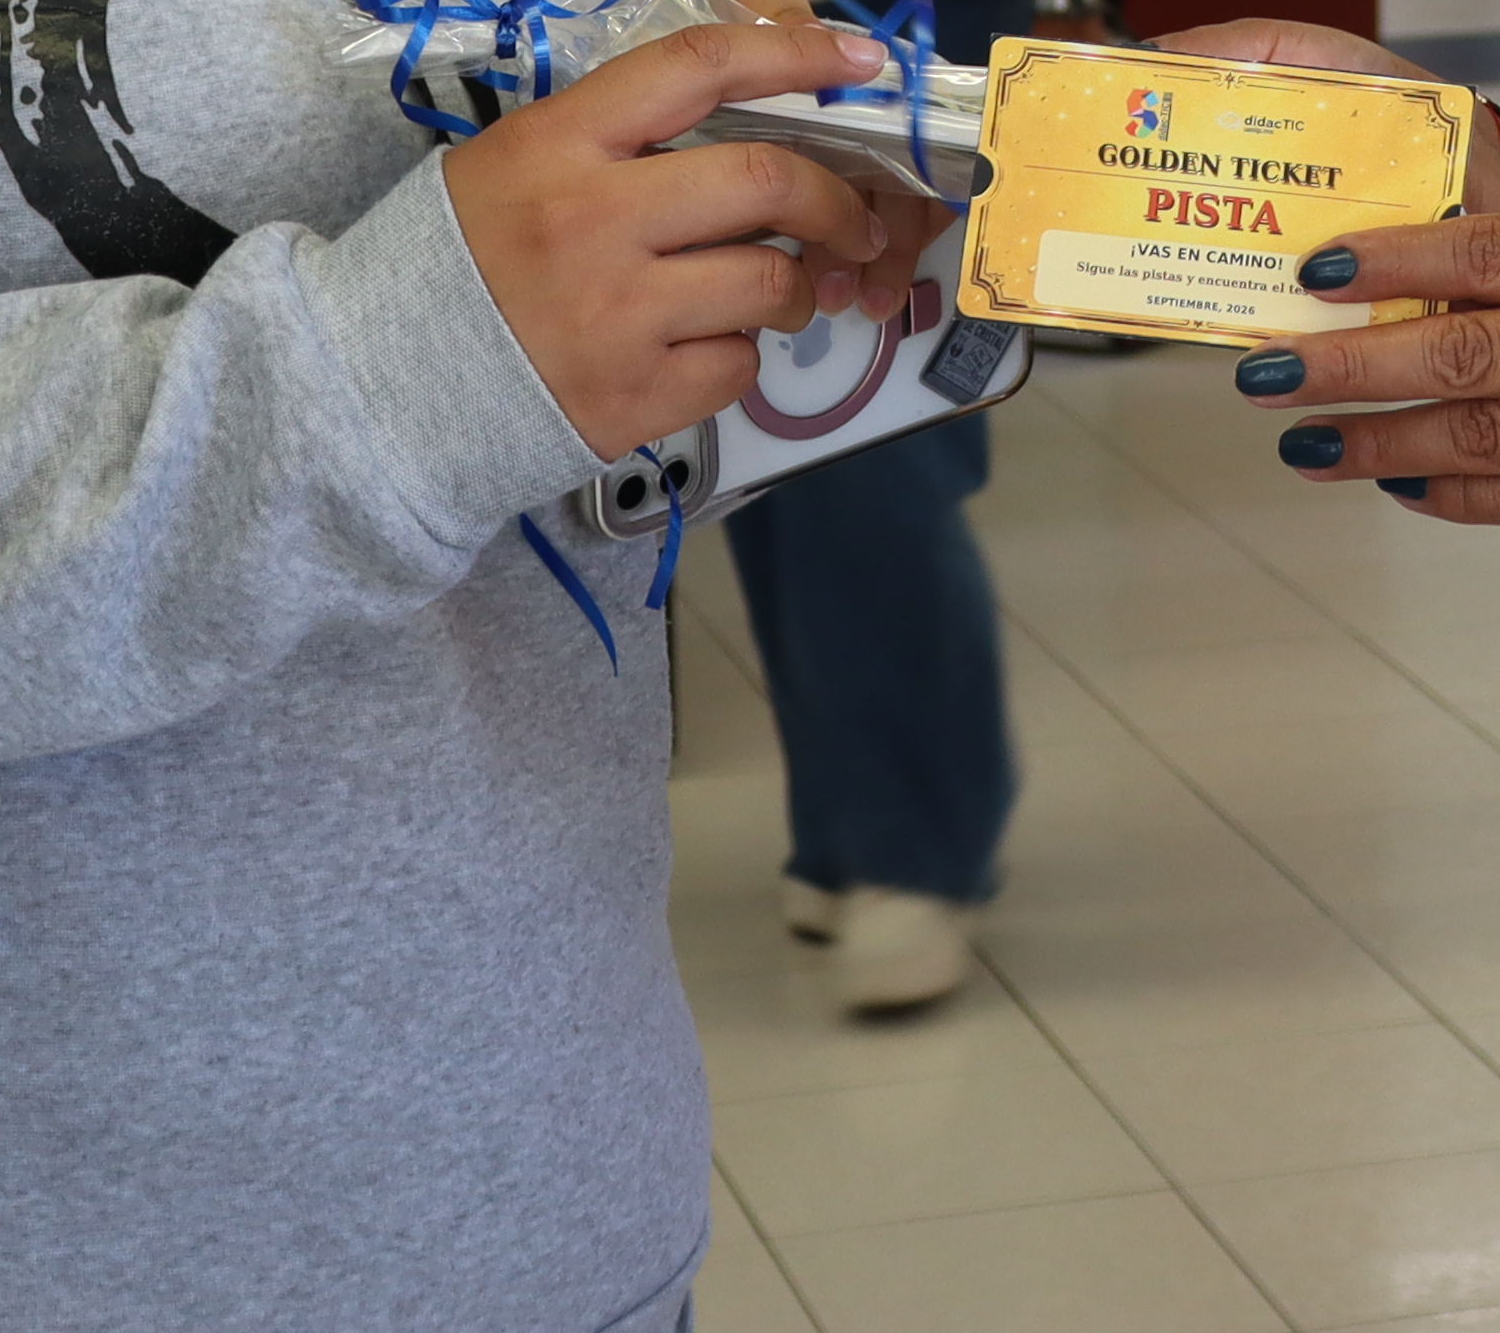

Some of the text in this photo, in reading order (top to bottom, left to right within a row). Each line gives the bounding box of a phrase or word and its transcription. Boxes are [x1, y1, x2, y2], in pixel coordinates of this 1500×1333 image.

[1243, 115, 1306, 132] didacTIC
[1098, 143, 1343, 190] GOLDEN TICKET
[1144, 187, 1283, 235] PISTA
[1130, 243, 1284, 271] ¡VAS EN CAMINO!
[1076, 261, 1309, 296] Sigue las pistas y encuentra el tes
[1146, 295, 1256, 316] SEPTIEMBRE, 2026
[974, 323, 1005, 352] CRISTAL
